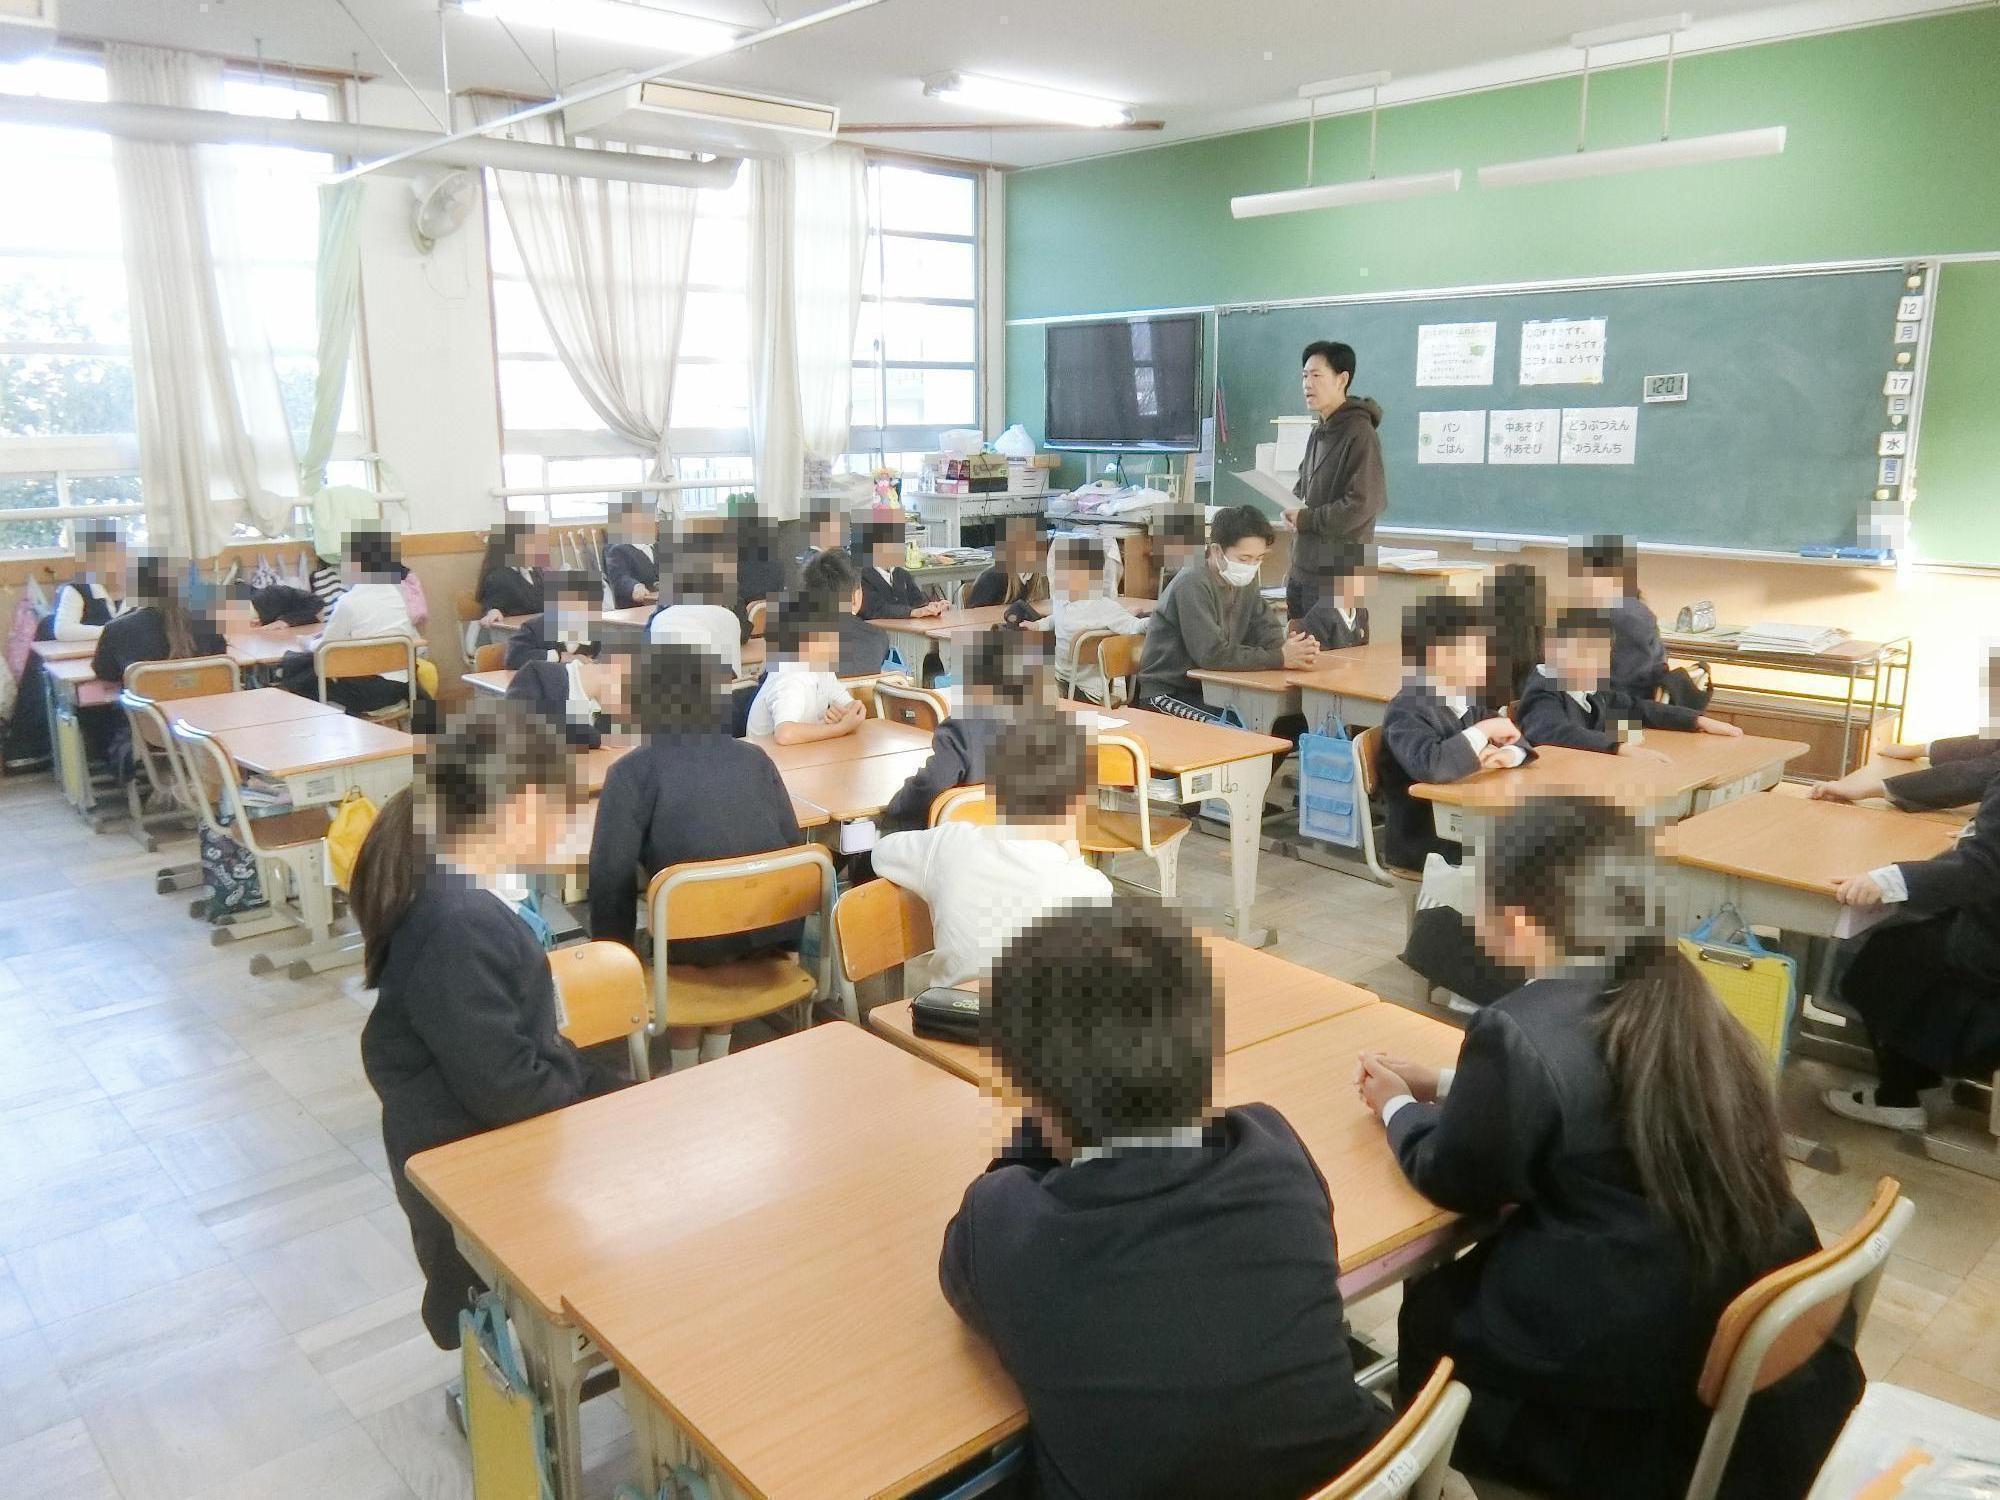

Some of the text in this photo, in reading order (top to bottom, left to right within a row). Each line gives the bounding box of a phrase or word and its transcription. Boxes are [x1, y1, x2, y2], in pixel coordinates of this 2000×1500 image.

[1903, 303, 1917, 315] 12
[1901, 326, 1914, 339] 月
[1892, 378, 1909, 390] 17
[1894, 398, 1905, 411] 日
[1442, 422, 1461, 433] パン
[1505, 421, 1545, 433] 中あそび
[1569, 419, 1631, 431] どうぶつえん
[1436, 444, 1465, 454] ごはん
[1503, 443, 1544, 455] 外あそび
[1571, 442, 1624, 454] ゆうえんち
[1886, 437, 1900, 451] 水
[1884, 459, 1898, 484] 曜日
